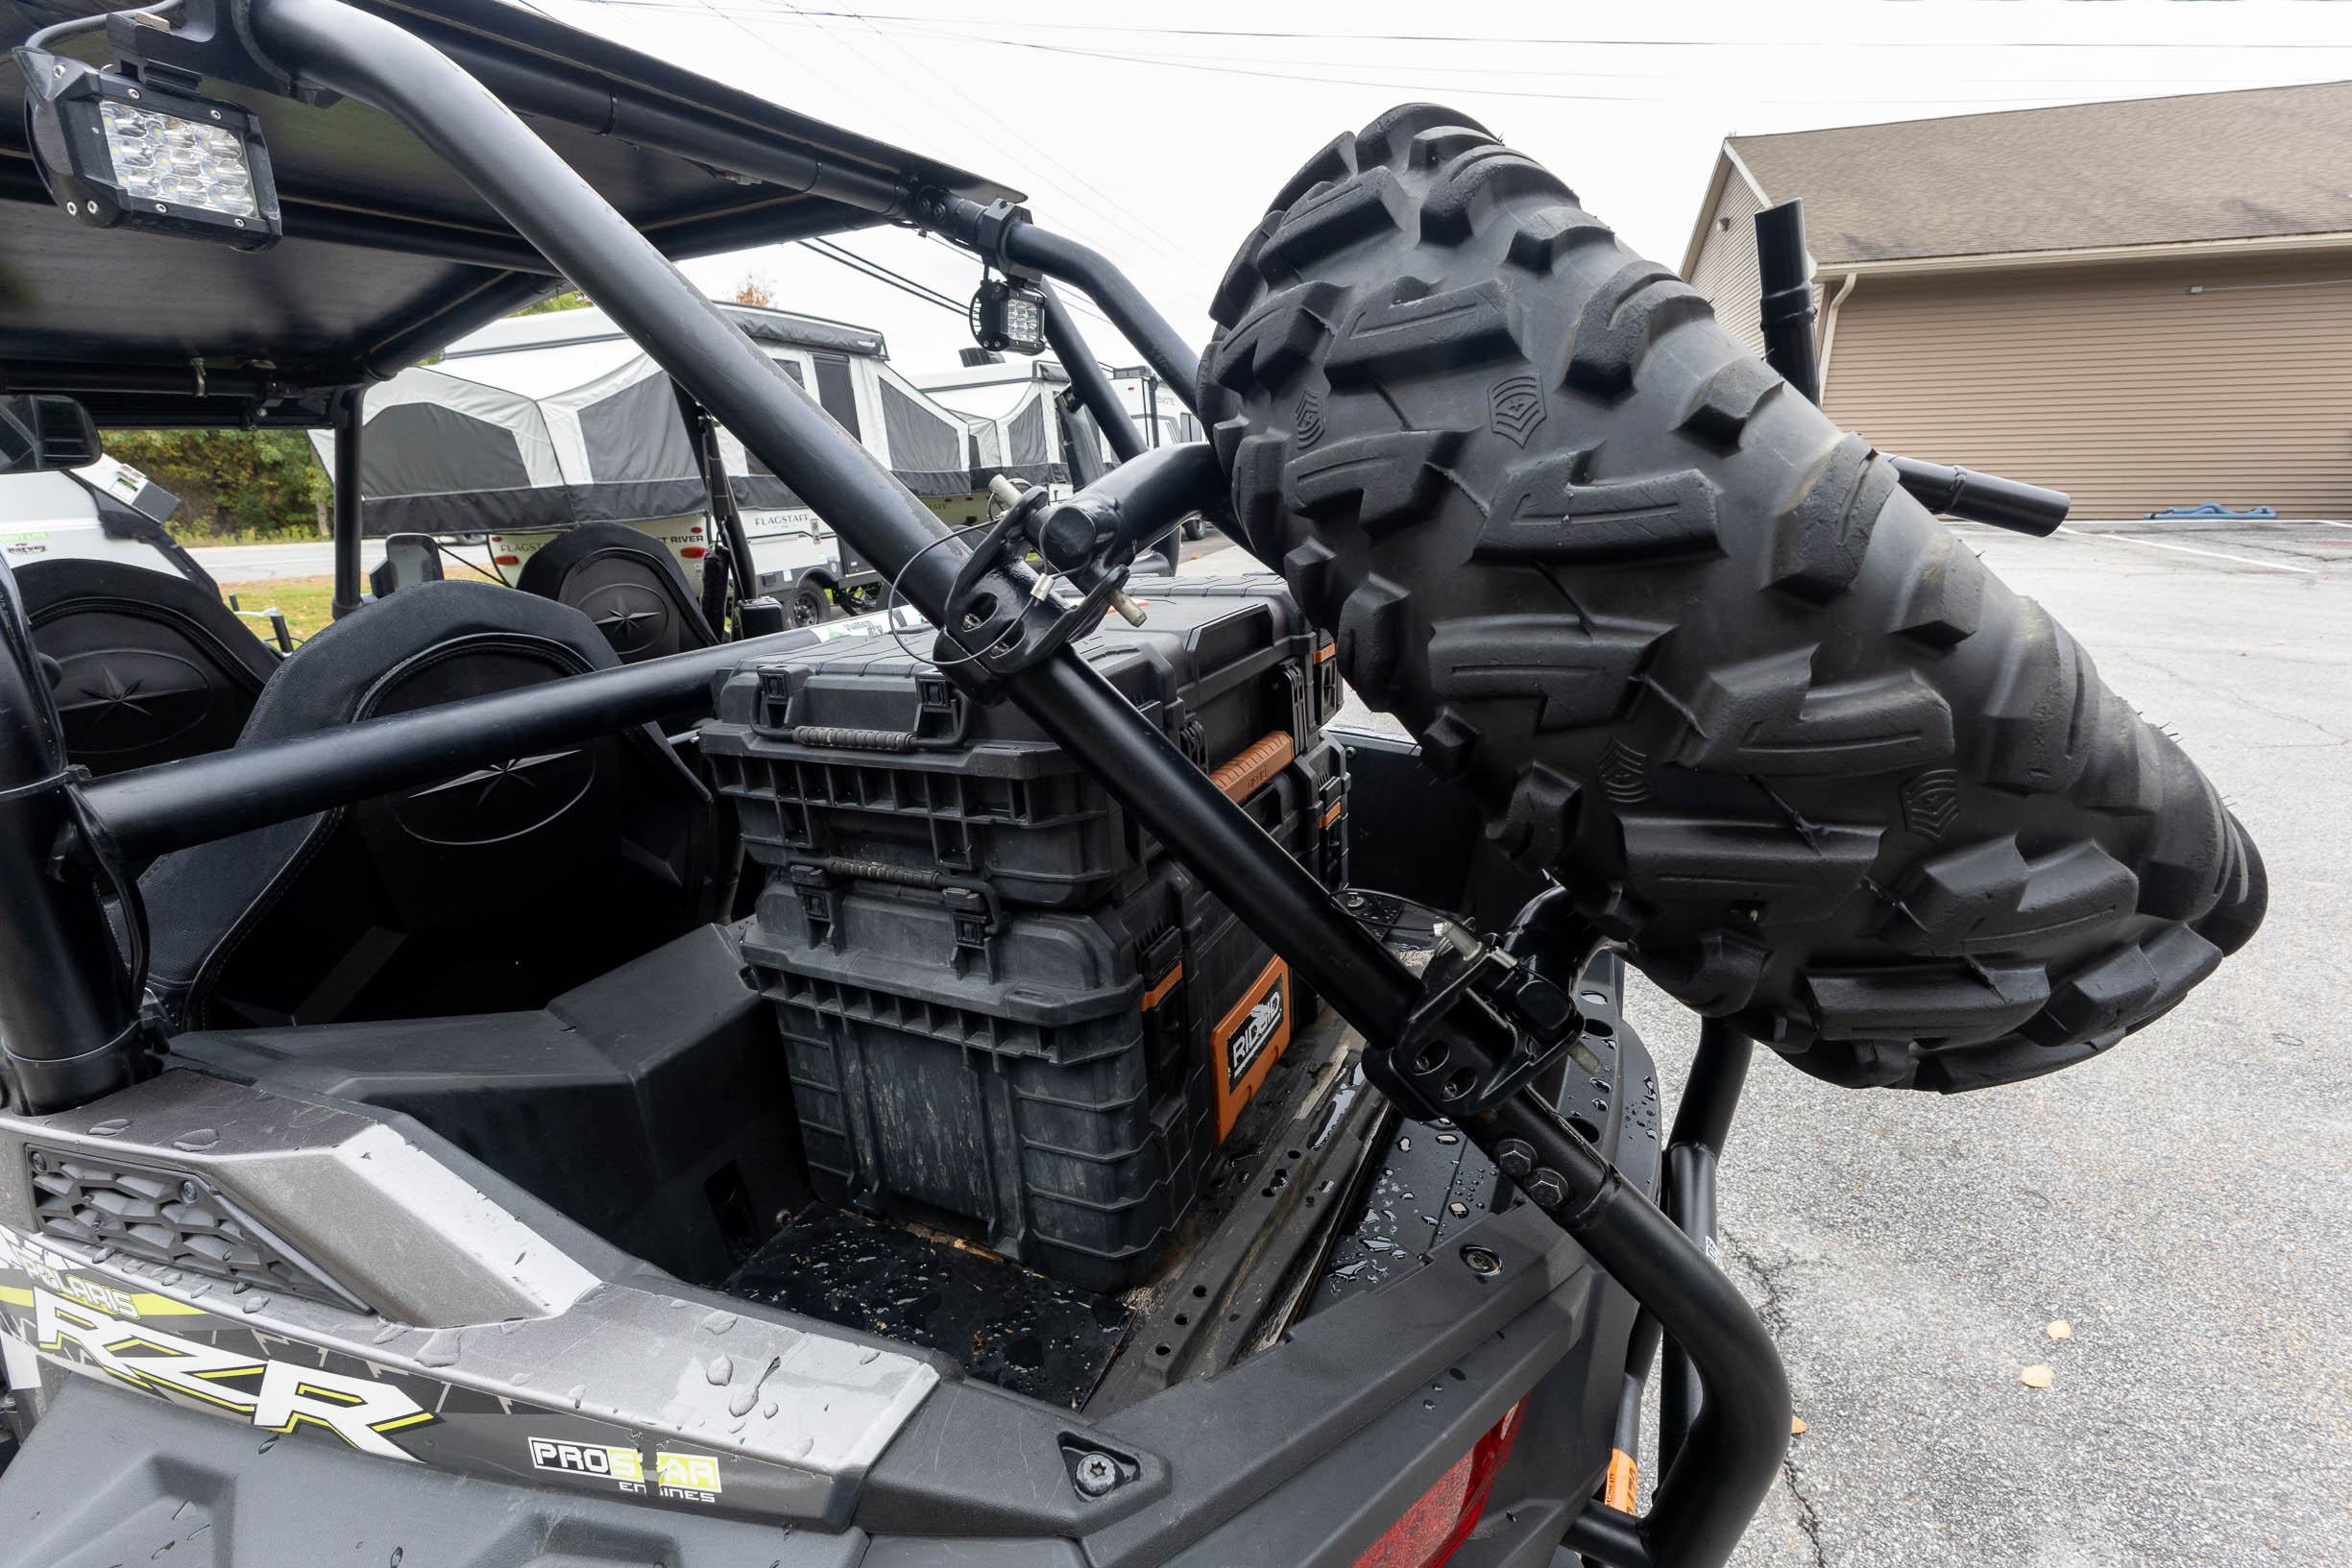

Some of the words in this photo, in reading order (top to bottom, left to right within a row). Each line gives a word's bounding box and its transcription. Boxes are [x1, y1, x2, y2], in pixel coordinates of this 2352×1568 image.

[755, 514, 809, 526] FLAGSTAFF
[500, 543, 547, 552] FLAGST
[669, 535, 704, 543] RIVER
[19, 1253, 139, 1319] POLARIS
[33, 1285, 435, 1463] RZR
[532, 1441, 715, 1487] PROSAR
[618, 1481, 715, 1504] ENINES
